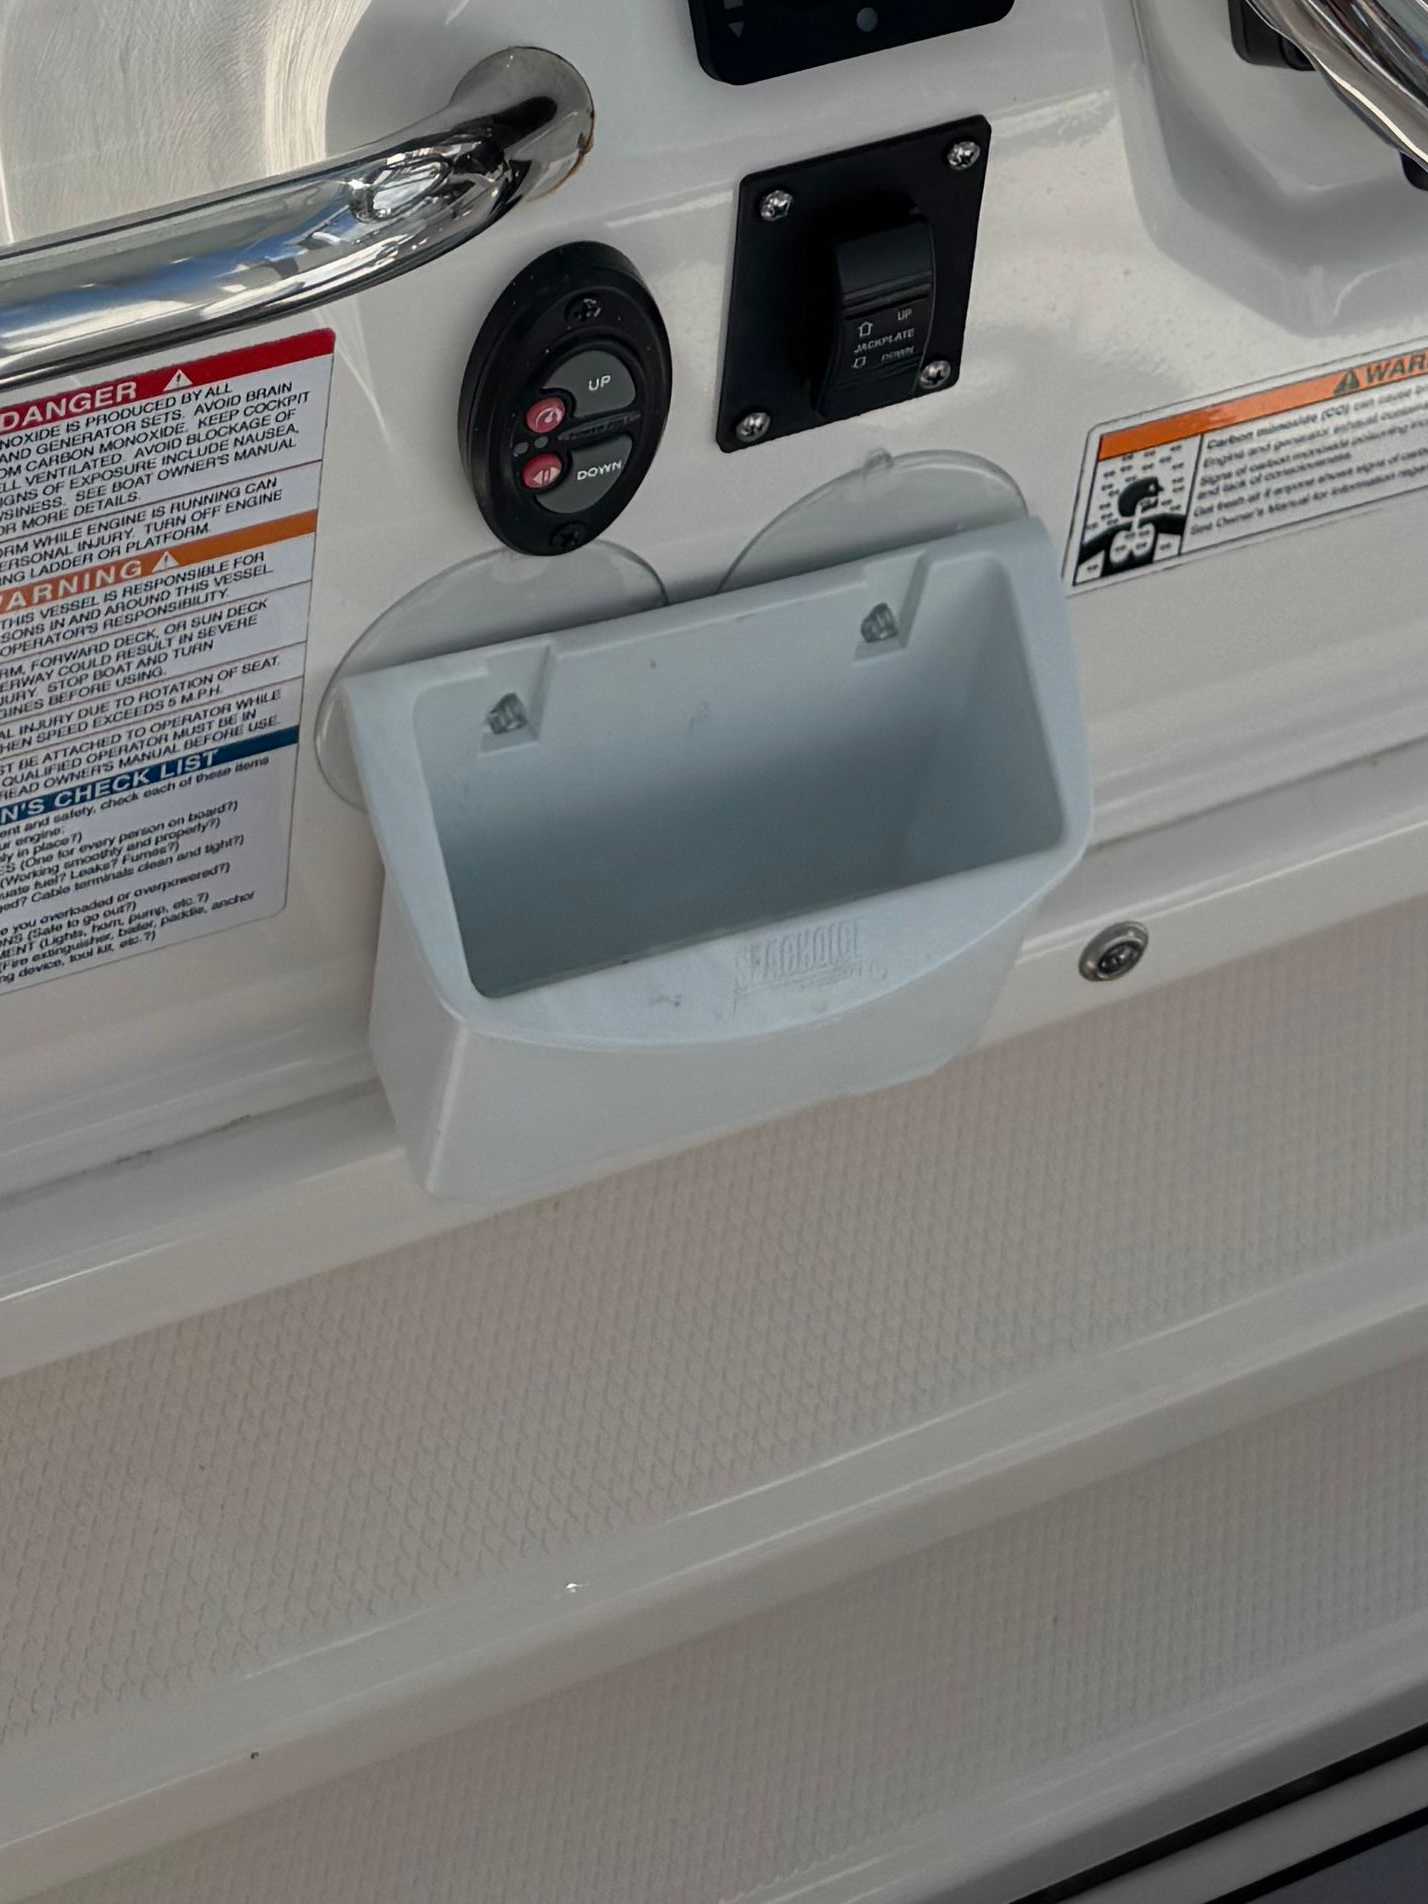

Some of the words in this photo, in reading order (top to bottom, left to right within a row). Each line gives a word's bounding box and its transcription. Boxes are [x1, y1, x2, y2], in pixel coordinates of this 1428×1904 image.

[853, 327, 916, 354] JACKPLATE
[897, 308, 913, 321] UP
[65, 419, 81, 434] IS
[84, 395, 177, 429] PRODUCED
[180, 389, 202, 405] BY
[204, 381, 233, 399] ALL
[588, 374, 612, 392] UP
[24, 444, 94, 473] CARBON
[197, 407, 240, 429] KEEP
[242, 390, 310, 418] COCKPIT
[35, 419, 136, 456] GENERATOR
[193, 393, 241, 416] AVOID
[245, 380, 292, 403] BRAIN
[133, 436, 182, 459] AVOID
[185, 413, 271, 446] BLOCKAGE
[274, 407, 296, 424] OF
[41, 480, 64, 497] OF
[69, 457, 157, 490] EXPOSURE
[161, 438, 229, 466] INCLUDE
[75, 484, 107, 503] SEE
[111, 472, 153, 493] BOAT
[156, 452, 229, 482] OWNER'S
[233, 435, 297, 462] MANUAL
[576, 458, 623, 482] DOWN
[21, 508, 69, 531] MORE
[53, 767, 150, 809] CHECK
[160, 748, 219, 779] LIST
